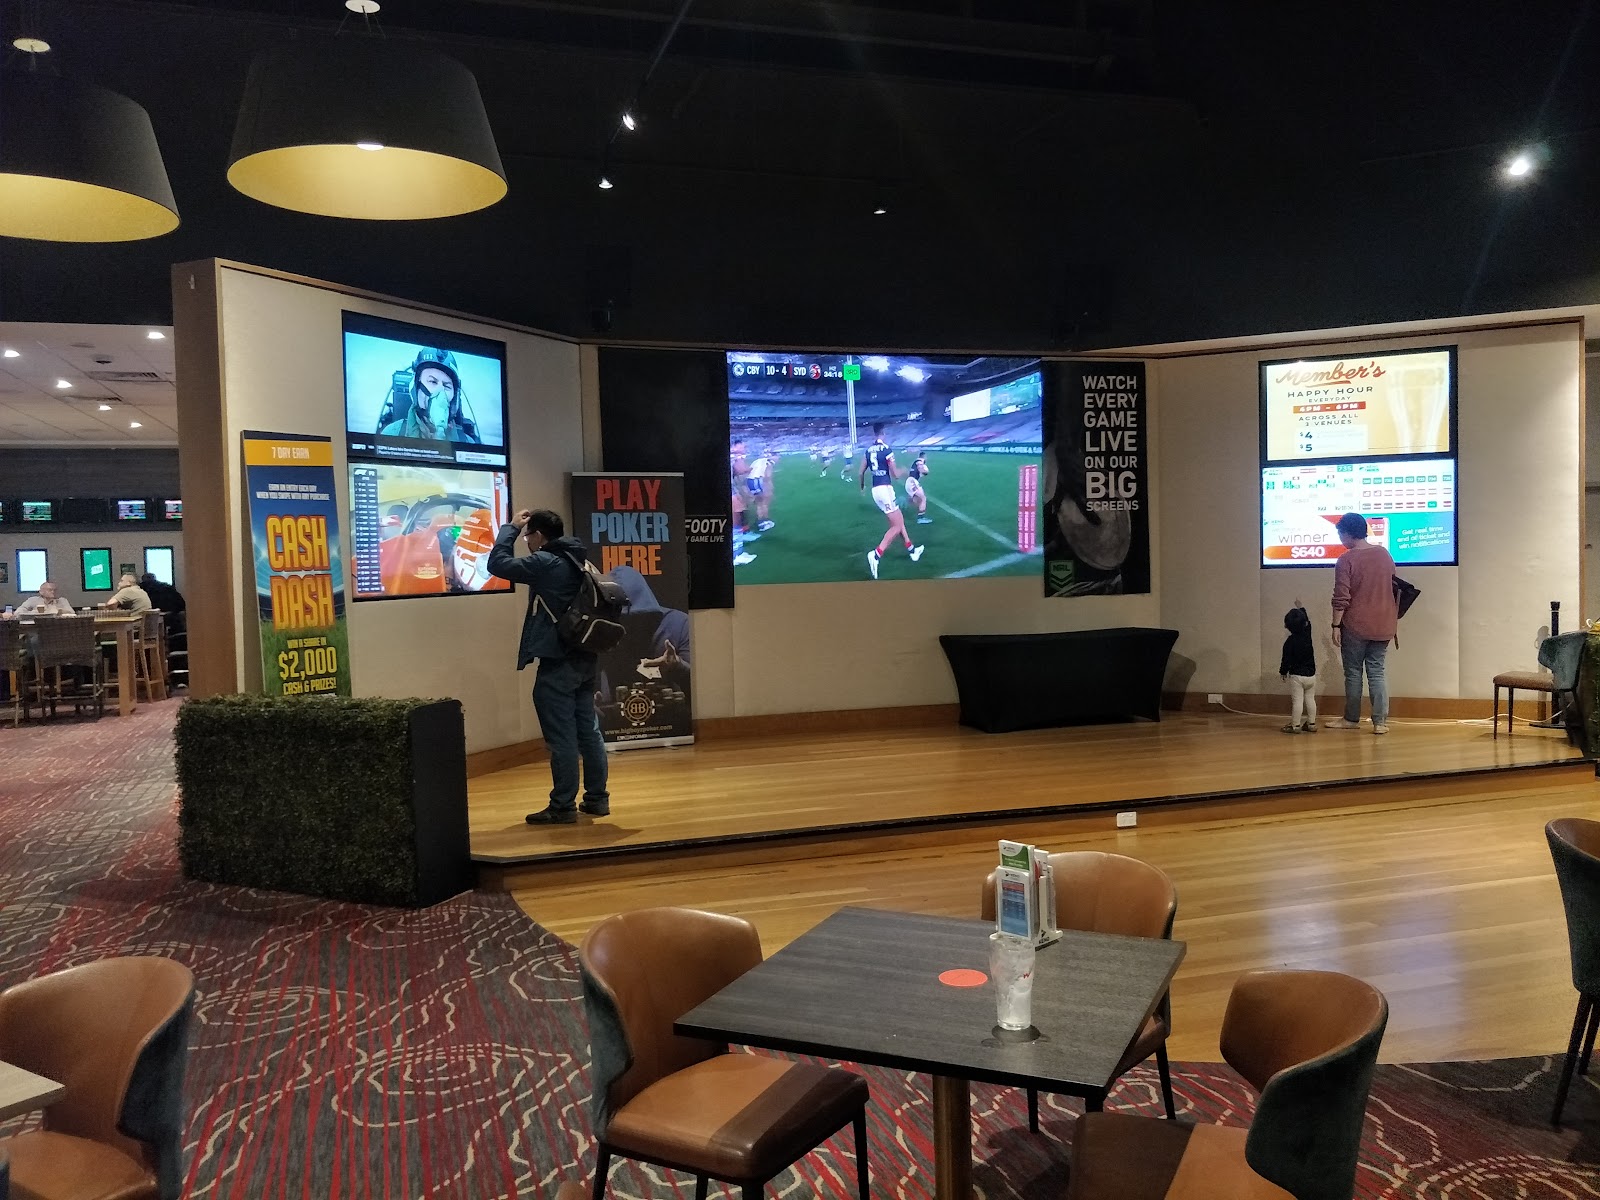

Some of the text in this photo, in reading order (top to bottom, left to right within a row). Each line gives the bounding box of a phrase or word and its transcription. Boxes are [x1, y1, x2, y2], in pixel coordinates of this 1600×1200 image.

[747, 365, 760, 375] CBY
[766, 365, 775, 375] 10
[782, 365, 787, 375] 4
[793, 366, 806, 376] SYD
[1276, 361, 1386, 386] Member's
[1082, 375, 1137, 390] WATCH
[1288, 386, 1373, 398] HAPPY HOUR
[1084, 393, 1138, 409] EVERY
[1084, 410, 1138, 428] GAME
[1299, 414, 1337, 422] ACROSS
[1314, 419, 1352, 427] VENUES
[1085, 430, 1138, 452] LIVE
[271, 446, 276, 459] 7
[869, 452, 879, 471] 5
[1084, 455, 1138, 469] ON OUR
[1086, 471, 1137, 499] BIG
[596, 478, 661, 510] PLAY
[1086, 500, 1139, 512] SCREENS
[591, 512, 670, 543] POKER
[685, 518, 728, 534] FOOTY
[1402, 528, 1414, 536] Get
[266, 516, 331, 571] CASH
[690, 535, 709, 543] GAME
[709, 535, 725, 543] LIVE
[1278, 533, 1329, 544] winner
[601, 544, 663, 576] HERE
[1291, 546, 1326, 558] $640
[1052, 564, 1071, 572] NRL
[271, 575, 335, 630] DASH
[278, 647, 338, 680] $2,000
[283, 681, 303, 695] CASH
[310, 677, 337, 692] PRIZES!
